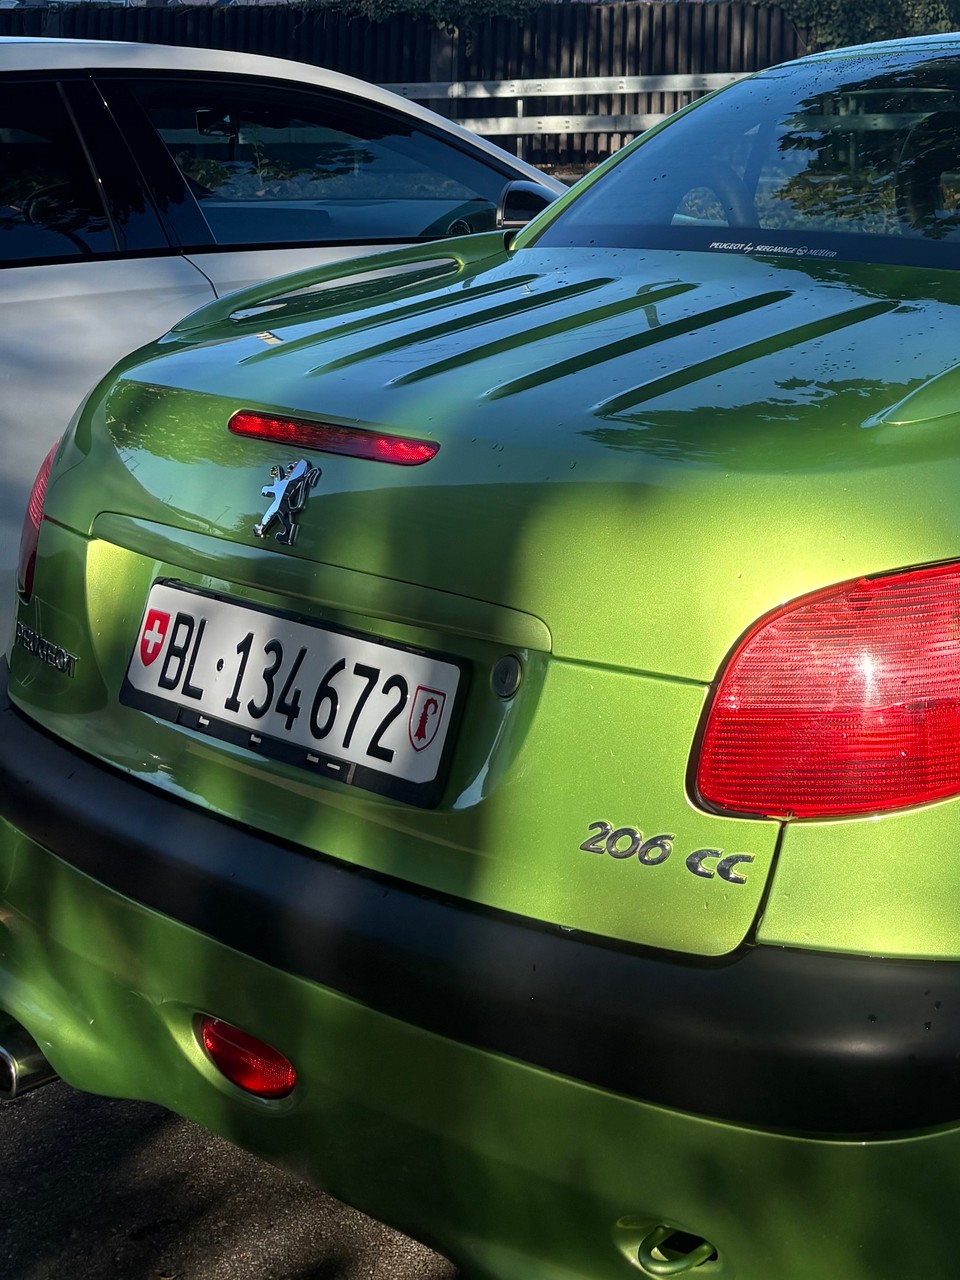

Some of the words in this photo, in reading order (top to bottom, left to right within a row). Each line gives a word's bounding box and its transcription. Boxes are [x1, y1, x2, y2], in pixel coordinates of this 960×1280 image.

[709, 241, 744, 251] PEUGEOT
[743, 242, 753, 254] by
[16, 621, 80, 678] PEUGEOT
[580, 821, 676, 866] 206
[686, 848, 756, 885] CC
